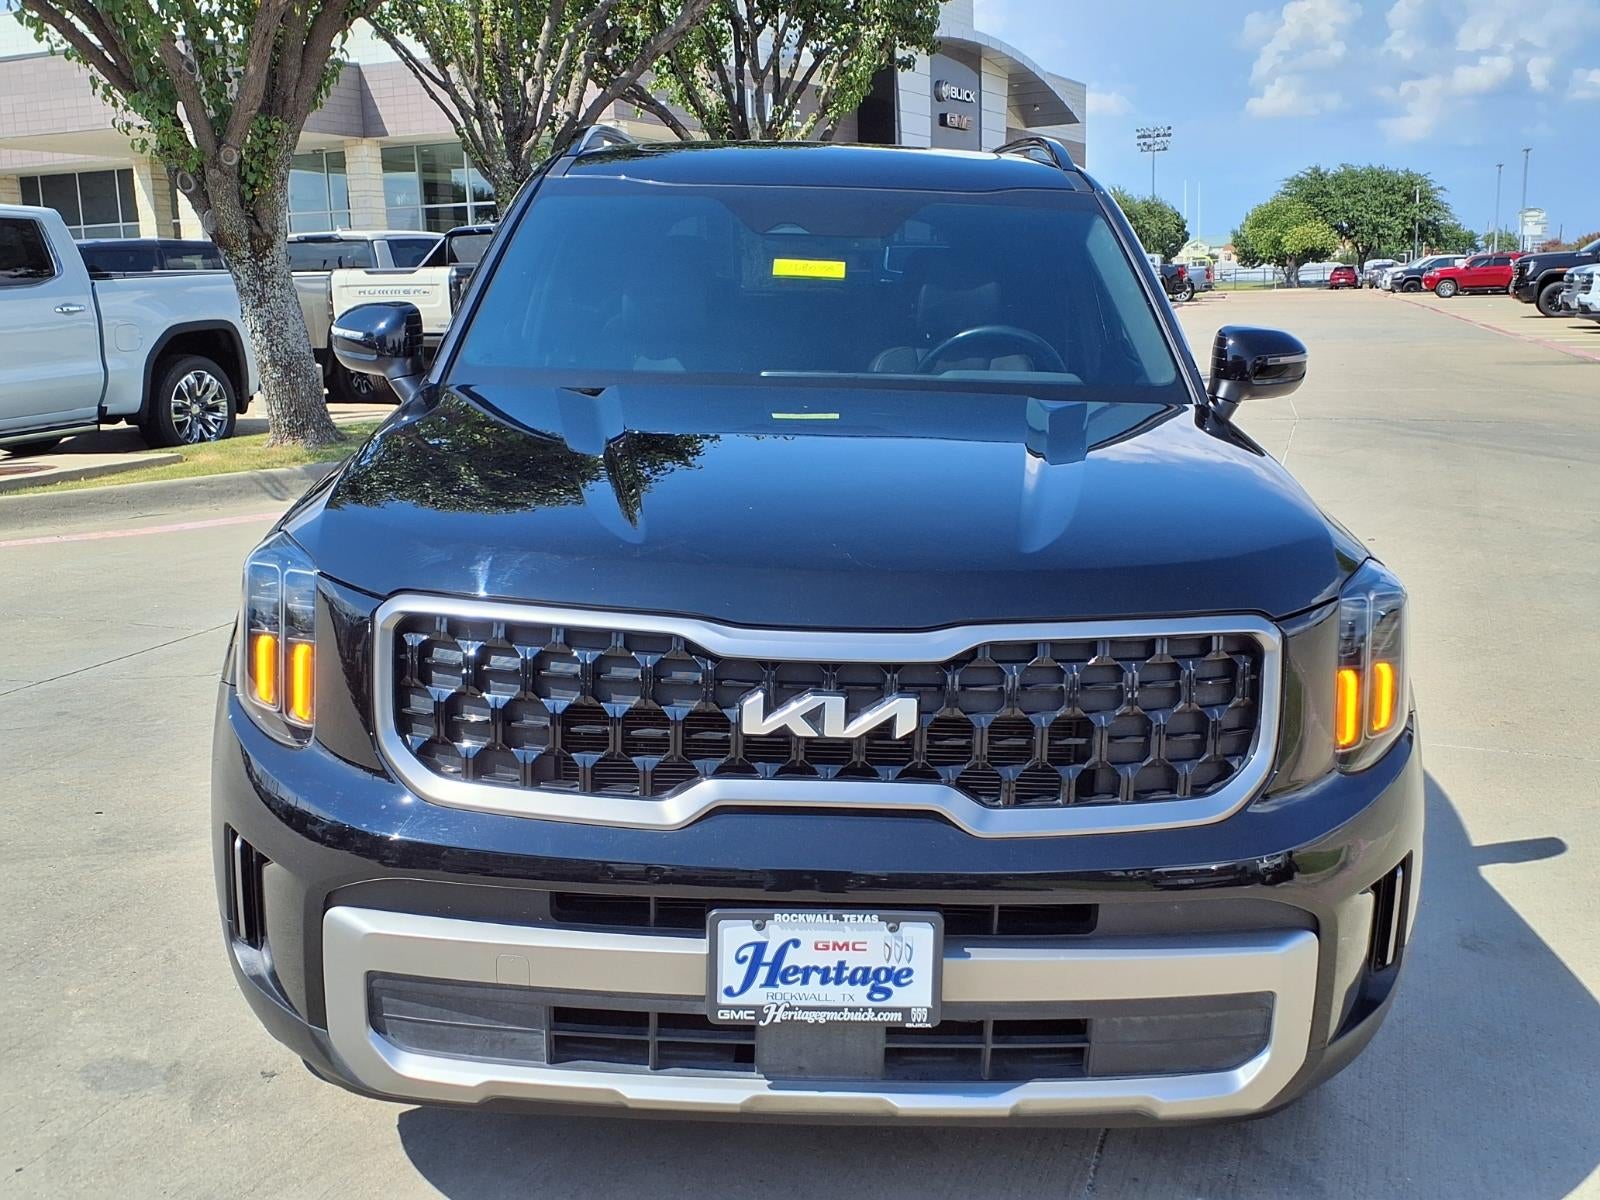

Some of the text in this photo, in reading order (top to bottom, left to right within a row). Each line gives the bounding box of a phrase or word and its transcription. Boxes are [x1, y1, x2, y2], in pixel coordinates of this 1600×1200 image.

[950, 86, 976, 103] BUICK
[742, 689, 918, 739] KIA
[773, 913, 879, 924] ROCKWALL, TEXAS
[814, 941, 867, 952] GMC
[722, 938, 915, 1003] Heritage
[766, 992, 855, 1002] ROCKWALL, TX
[717, 1002, 903, 1026] GMC Heritagegmcbuick.com
